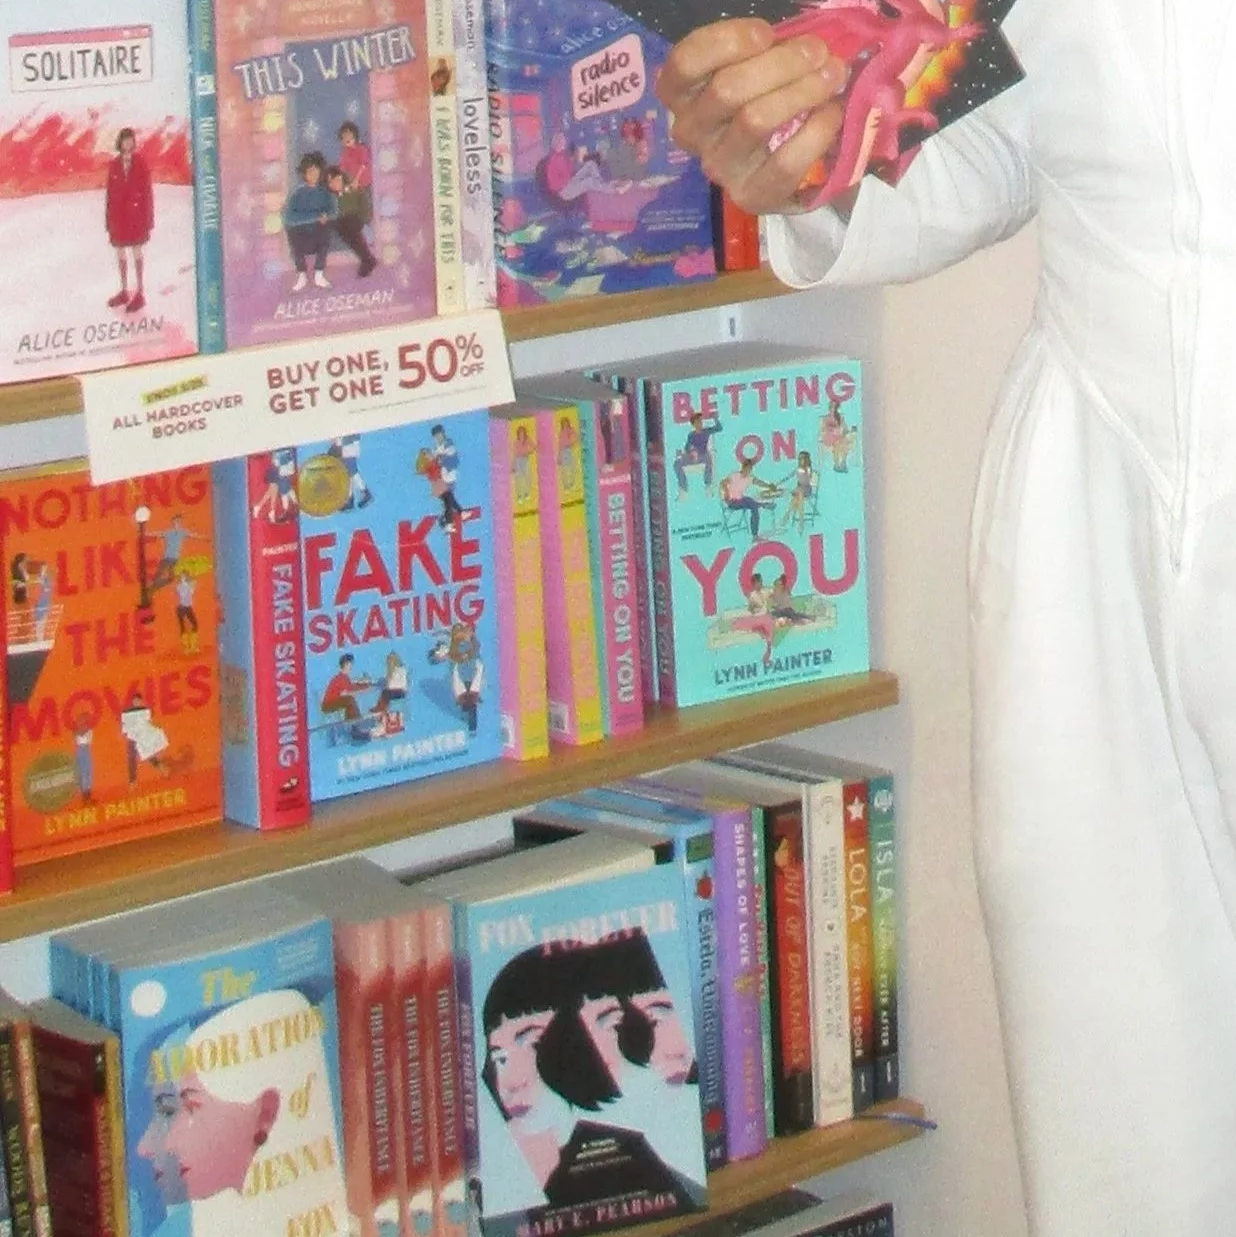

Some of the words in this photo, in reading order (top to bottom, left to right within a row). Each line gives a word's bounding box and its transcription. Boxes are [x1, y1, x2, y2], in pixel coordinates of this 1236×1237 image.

[22, 44, 142, 83] SOLITAIRE
[233, 53, 304, 100] THIS
[314, 26, 417, 82] WINTER
[580, 50, 631, 86] radio
[577, 72, 641, 109] silence
[462, 96, 487, 195] loveless
[273, 299, 322, 320] ALICE
[325, 288, 395, 312] OSEMAN
[17, 327, 75, 353] ALICE
[83, 314, 165, 344] OSEMAN
[266, 360, 323, 390] BUY
[325, 349, 390, 379] ONE,
[460, 361, 485, 378] OFF
[111, 413, 142, 431] ALL
[146, 393, 244, 424] HARDCOVER
[268, 385, 319, 415] GET
[329, 374, 385, 403] ONE
[672, 372, 857, 424] BETTING
[151, 416, 207, 440] BOOKS
[735, 428, 797, 466] ON
[303, 506, 482, 610] FAKE
[679, 528, 861, 618] YOU
[64, 615, 156, 666] THE
[307, 585, 485, 655] SKATING
[714, 664, 759, 687] LYNN
[762, 648, 833, 673] PAINTER
[10, 666, 214, 745] MOVIES
[845, 847, 867, 923] LOLA
[202, 966, 258, 1004] The
[145, 1004, 329, 1086] ADORATION
[241, 1135, 336, 1197] JENNA
